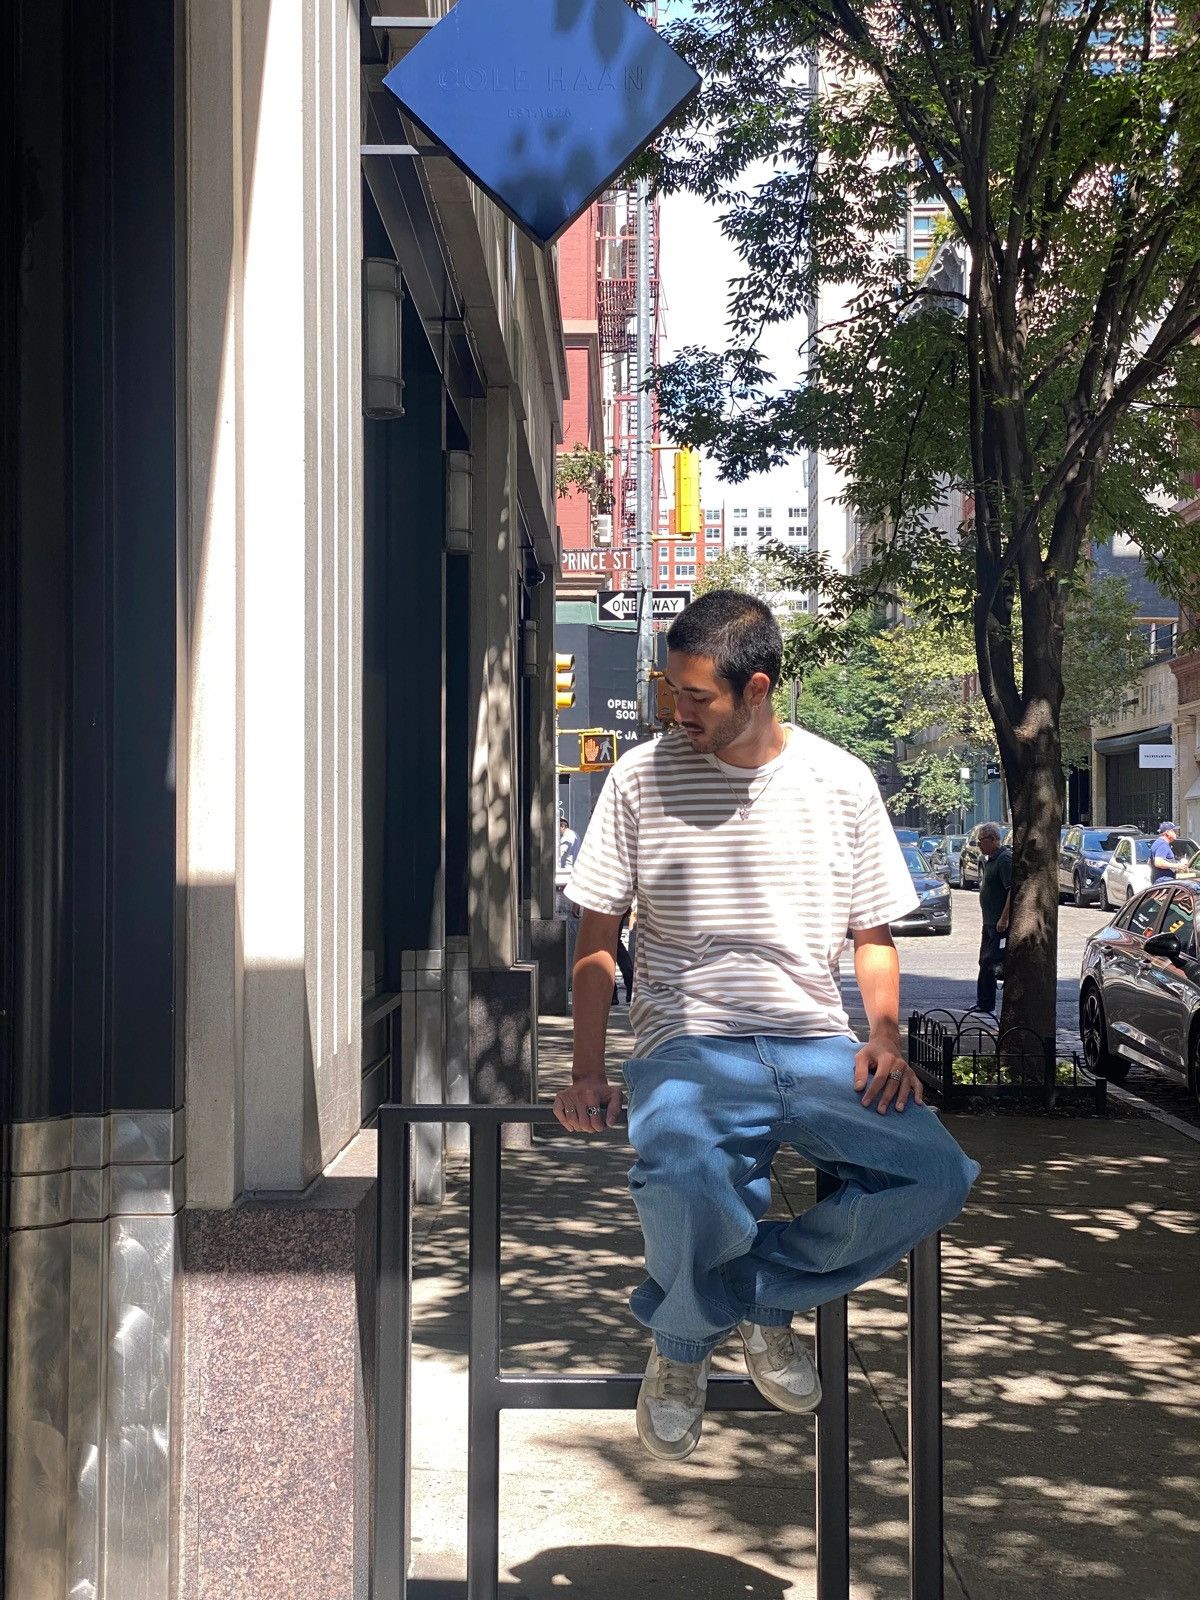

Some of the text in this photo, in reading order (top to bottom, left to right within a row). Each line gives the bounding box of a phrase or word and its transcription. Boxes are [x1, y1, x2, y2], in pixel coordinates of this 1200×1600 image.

[438, 65, 643, 91] COLE HAAN
[562, 551, 629, 571] PRINCE ST
[612, 600, 679, 612] ONE WAY
[607, 699, 637, 710] OPENI
